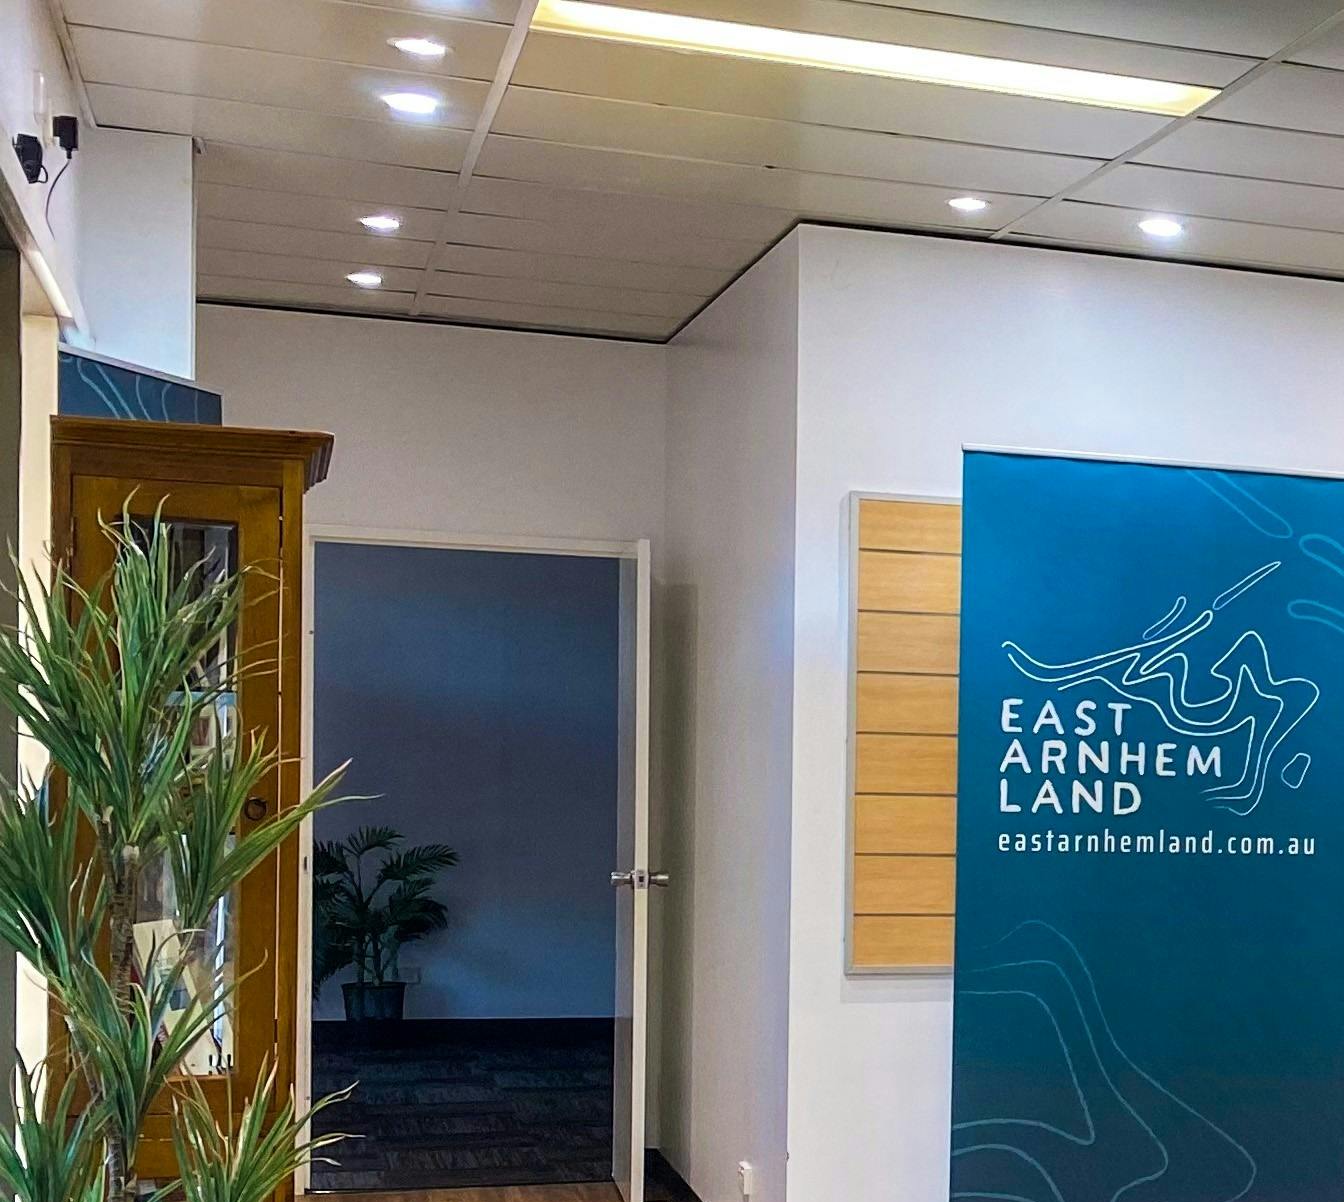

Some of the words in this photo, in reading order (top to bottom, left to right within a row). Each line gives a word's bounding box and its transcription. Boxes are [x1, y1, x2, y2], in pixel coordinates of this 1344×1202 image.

[1001, 698, 1133, 736] EAST
[999, 739, 1223, 779] ARNHEM
[999, 779, 1142, 815] LAND
[998, 829, 1316, 856] eastarnhemland.com.au
